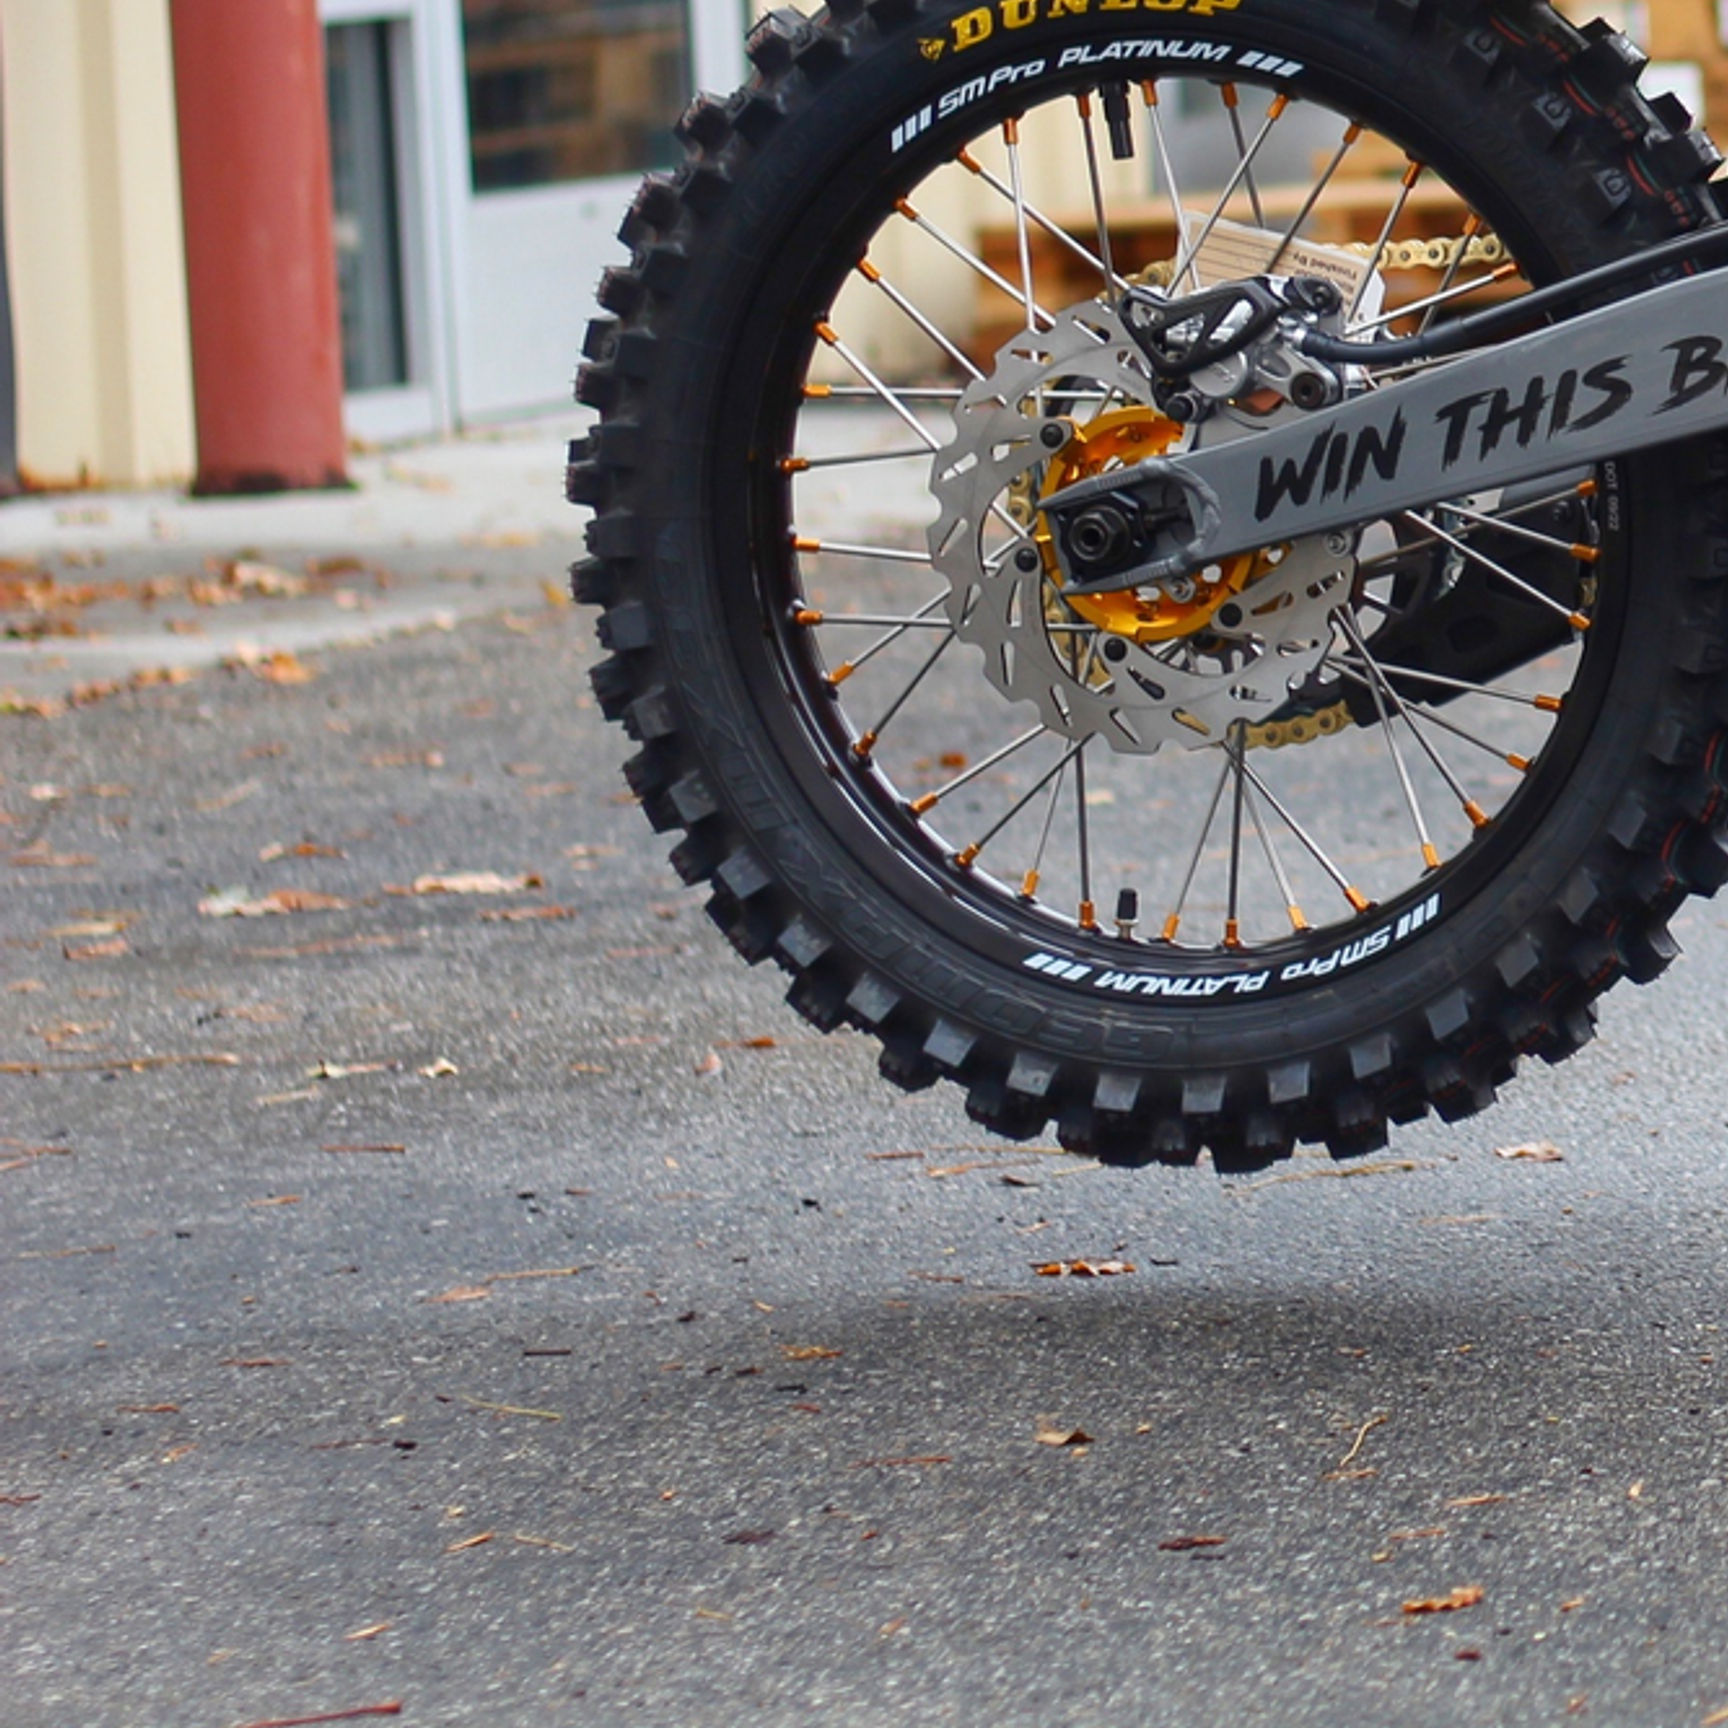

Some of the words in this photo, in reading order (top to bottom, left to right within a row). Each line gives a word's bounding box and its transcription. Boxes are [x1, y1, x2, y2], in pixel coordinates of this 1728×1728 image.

[1056, 38, 1231, 69] PLATINUM
[1253, 403, 1406, 523] WIN
[1433, 354, 1633, 473] THIS
[1604, 460, 1618, 489] DOT
[1095, 969, 1270, 997] PLATINUM
